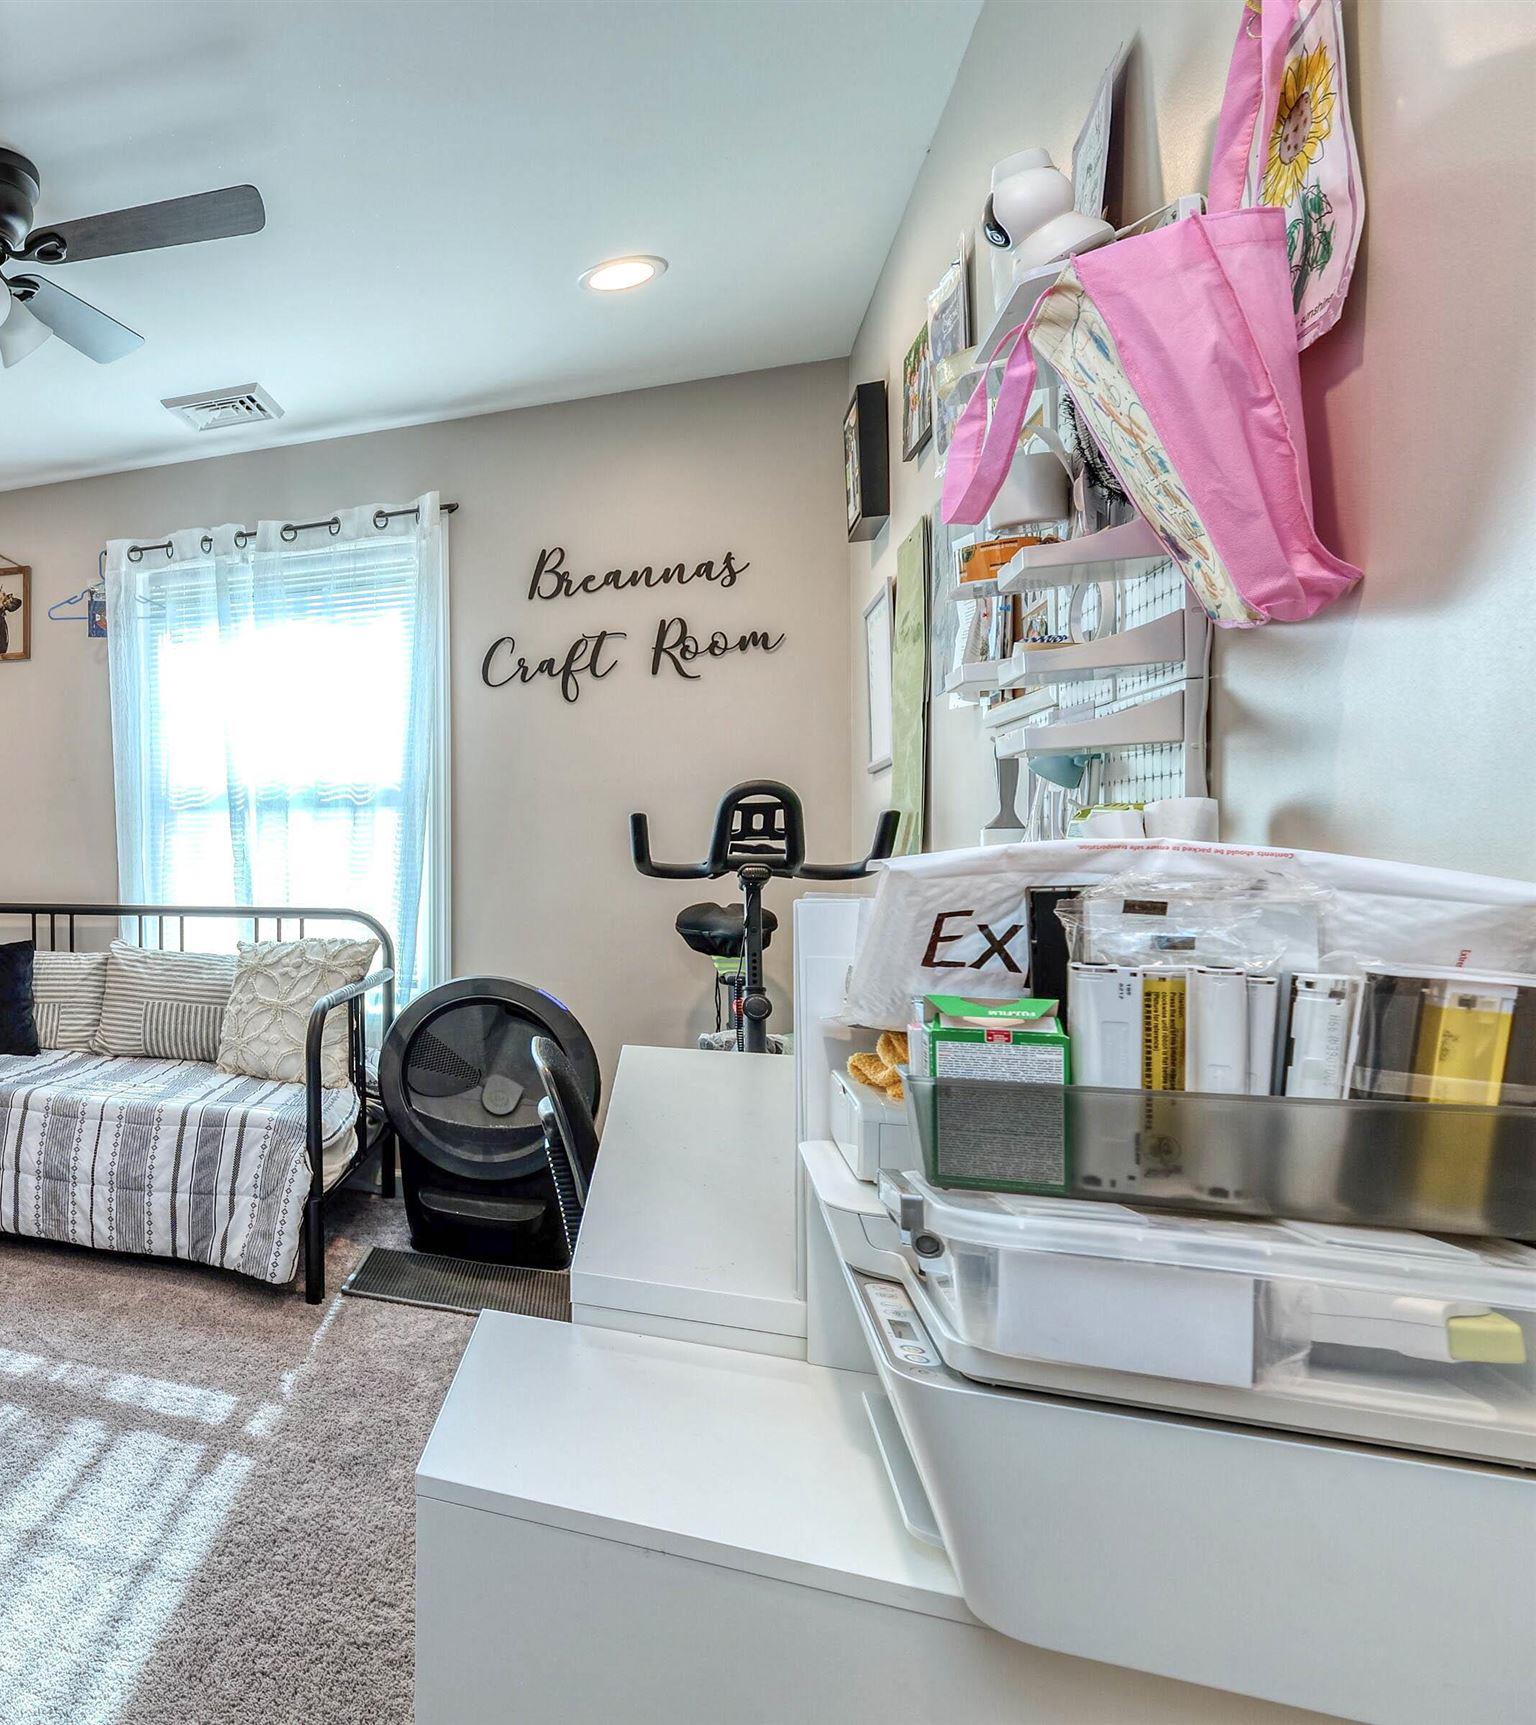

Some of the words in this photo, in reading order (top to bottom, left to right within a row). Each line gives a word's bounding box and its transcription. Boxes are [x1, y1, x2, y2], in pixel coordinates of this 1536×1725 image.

[527, 546, 751, 601] Breannas
[480, 629, 628, 703] Craft
[650, 616, 786, 681] Room
[1129, 844, 1145, 852] safe
[1181, 845, 1212, 855] packed
[1214, 848, 1224, 856] be
[1226, 849, 1255, 858] should
[1256, 851, 1295, 860] Contents
